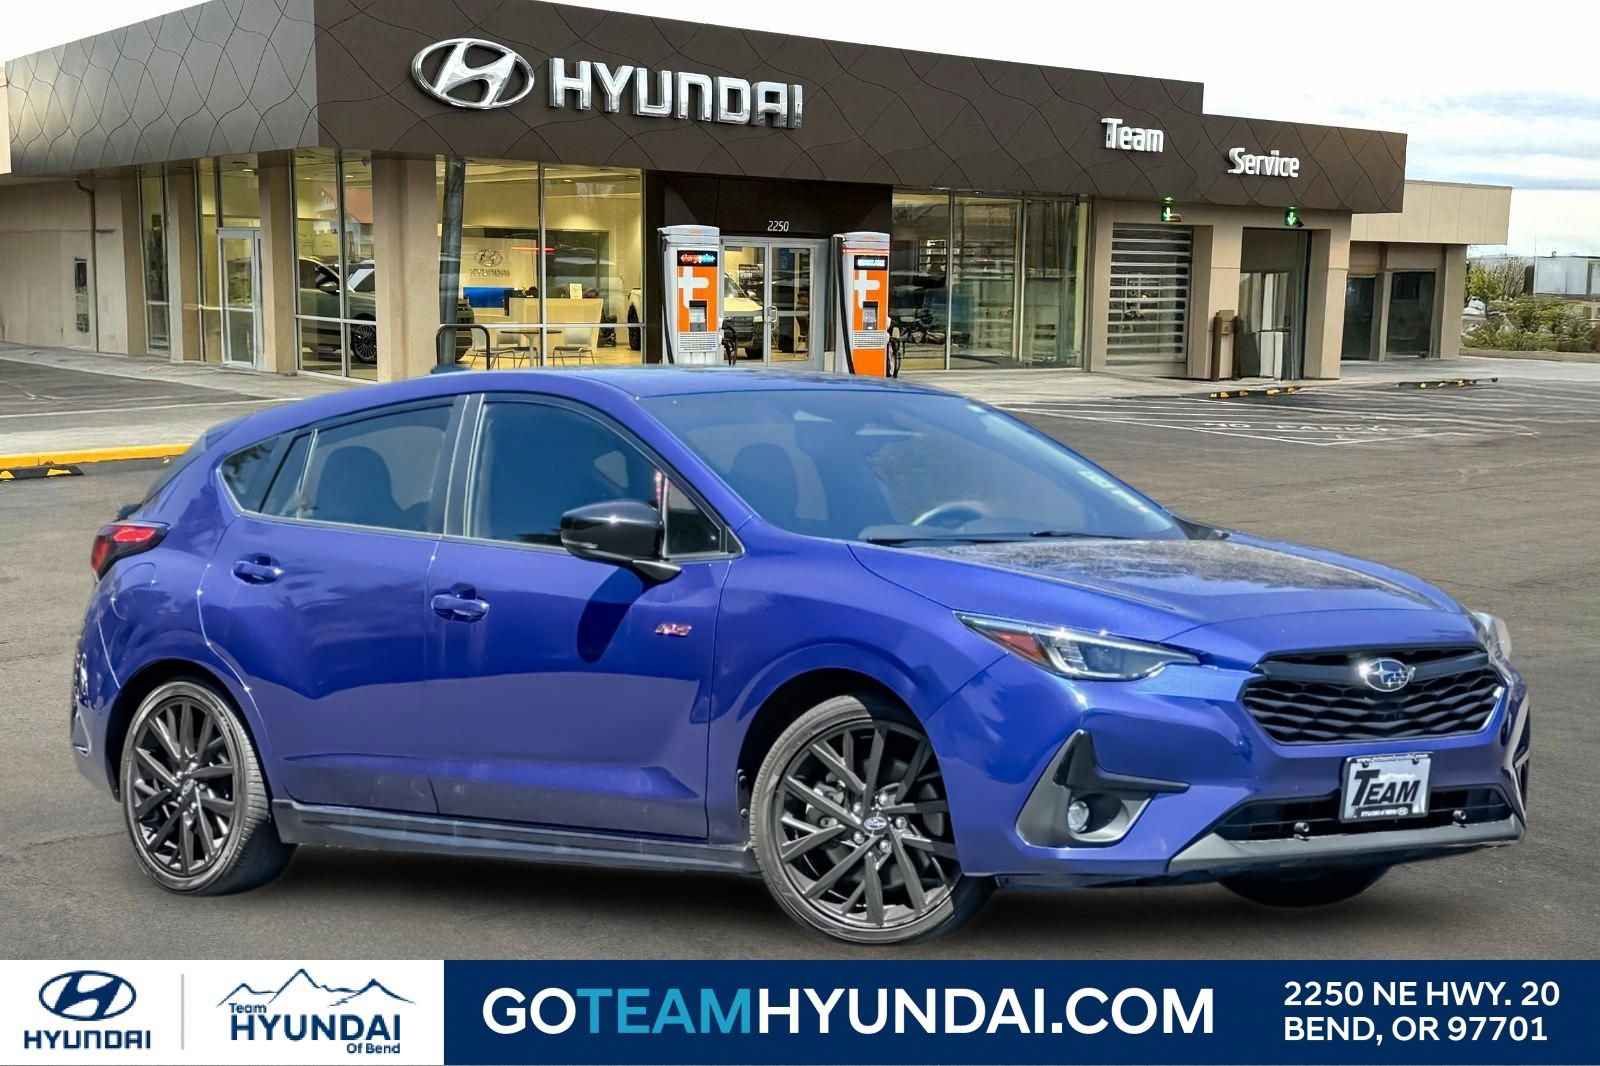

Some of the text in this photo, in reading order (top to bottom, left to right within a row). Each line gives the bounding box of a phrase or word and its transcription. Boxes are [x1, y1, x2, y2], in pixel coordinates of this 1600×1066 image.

[549, 57, 803, 128] HYUNDAI
[1101, 118, 1164, 153] Team
[1227, 146, 1301, 178] Service
[767, 220, 790, 232] 2250
